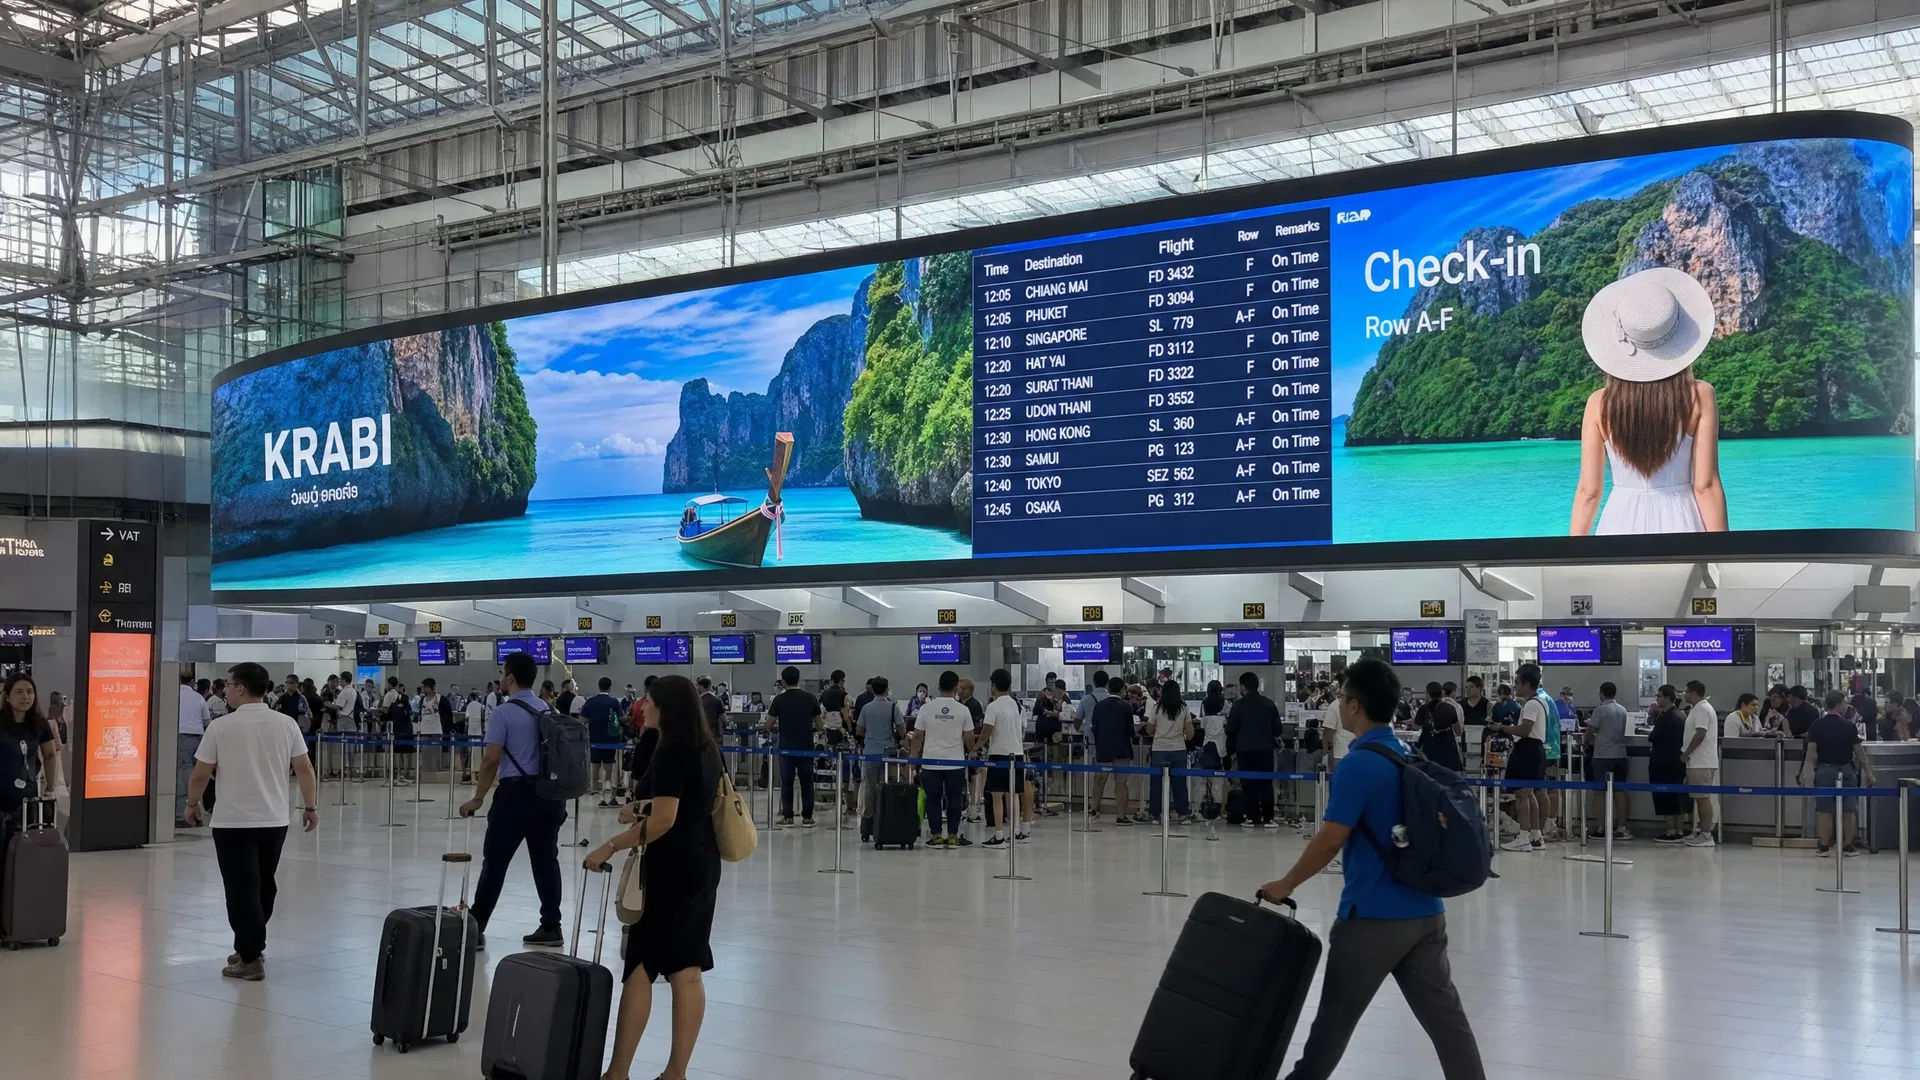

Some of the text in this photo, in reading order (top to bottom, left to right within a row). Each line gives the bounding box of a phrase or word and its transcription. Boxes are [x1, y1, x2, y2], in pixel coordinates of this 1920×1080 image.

[984, 220, 1320, 276] Time Destination Flight Row Remarks
[1365, 235, 1540, 292] Check-in
[984, 250, 1319, 303] 12:05 CHIANG MAI FD 3432 F On Time
[984, 276, 1319, 326] 12:05 PHUKET FD 3094 F On Time
[984, 302, 1319, 350] 12:10 SINGAPORE SL 779 A-F On Time
[1366, 308, 1453, 338] Row A-F
[984, 328, 1320, 374] 12:20 HAT YAI FD 3112 F On Time
[984, 355, 1320, 398] 12:20 SURAT THANI FD 3322 F On Time
[984, 381, 1320, 422] 12:25 UDON THANI FD 3552 F On Time
[264, 413, 392, 482] KRABI
[984, 407, 1320, 445] 12:30 HONG KONG SL 360 A-F On Time
[984, 433, 1320, 469] 12:30 SAMUI PG 123 A-F On Time
[984, 460, 1320, 493] 12:40 TOKYO SEZ 562 A-F On Time
[984, 486, 1320, 516] 12:45 OSAKA PG 312 A-F On Time
[119, 530, 140, 541] VAT
